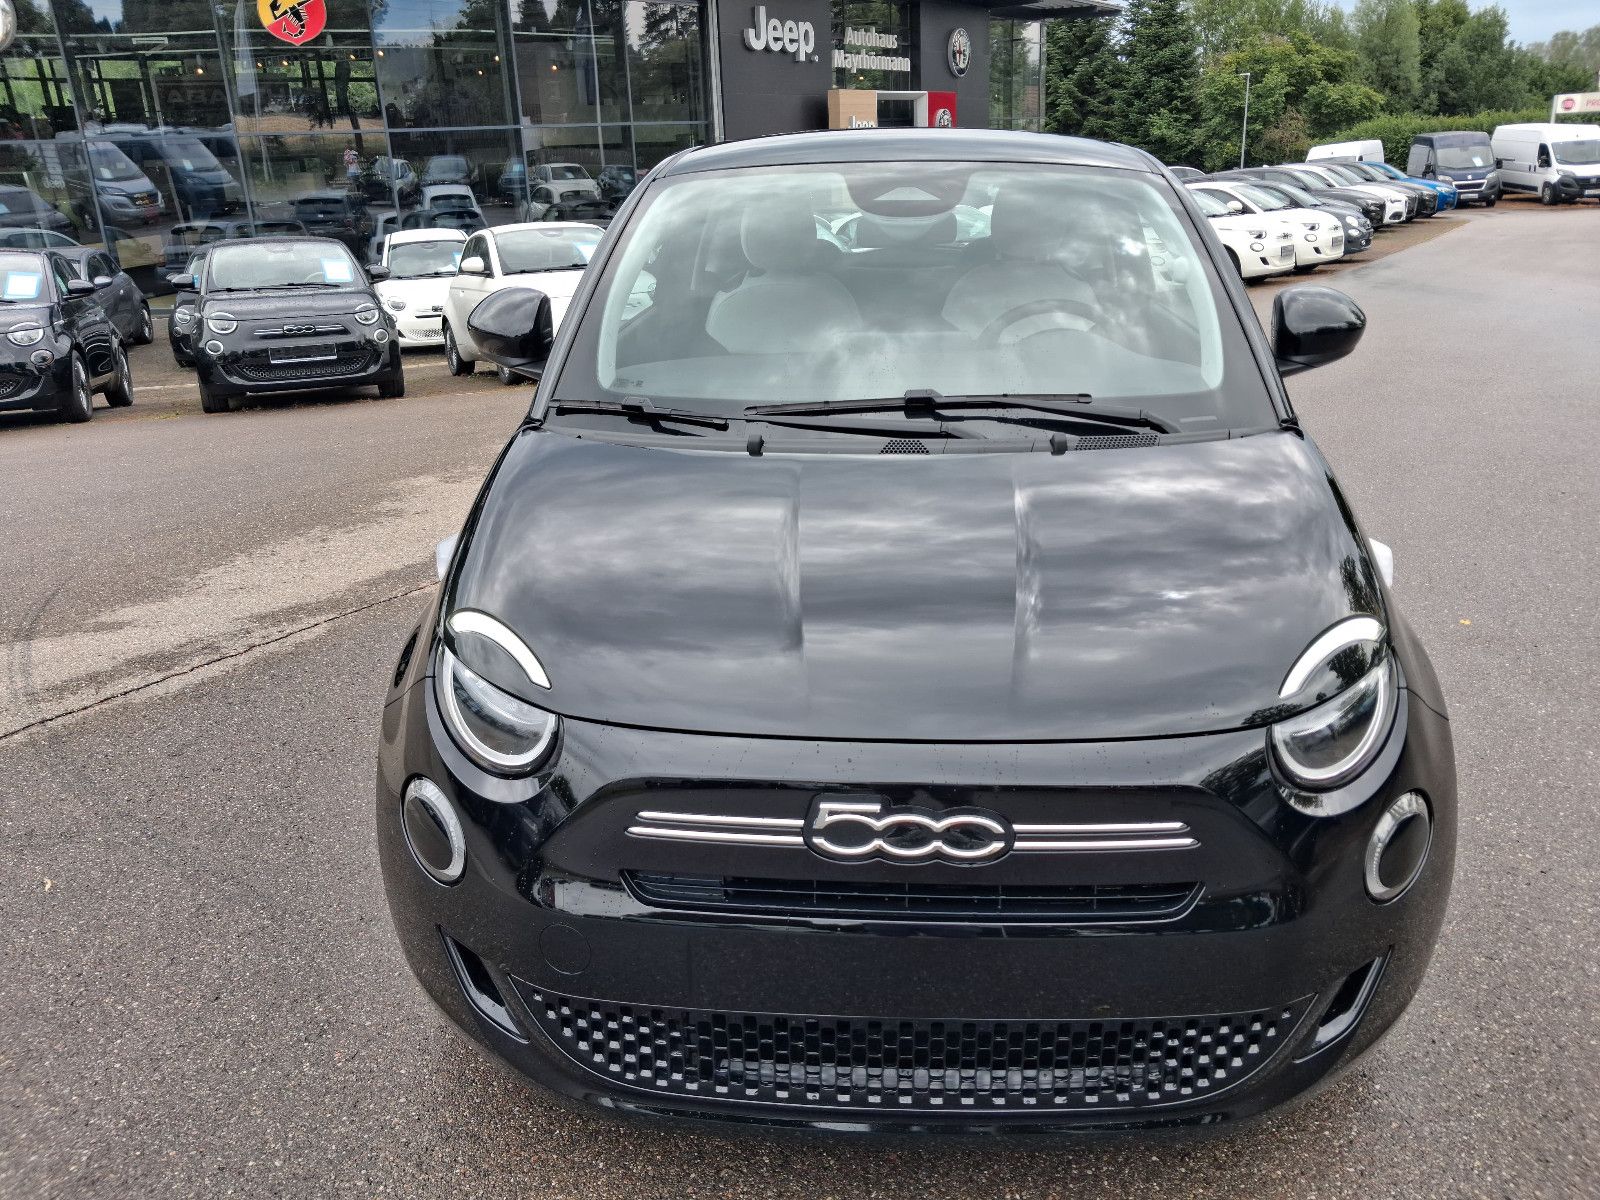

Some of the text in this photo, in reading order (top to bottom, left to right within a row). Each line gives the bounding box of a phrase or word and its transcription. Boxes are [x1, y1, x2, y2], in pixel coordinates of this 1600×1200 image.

[746, 5, 815, 61] Jeep
[843, 26, 898, 48] Autohaus
[831, 48, 911, 73] Mayrhörmann
[812, 801, 1006, 859] 500
